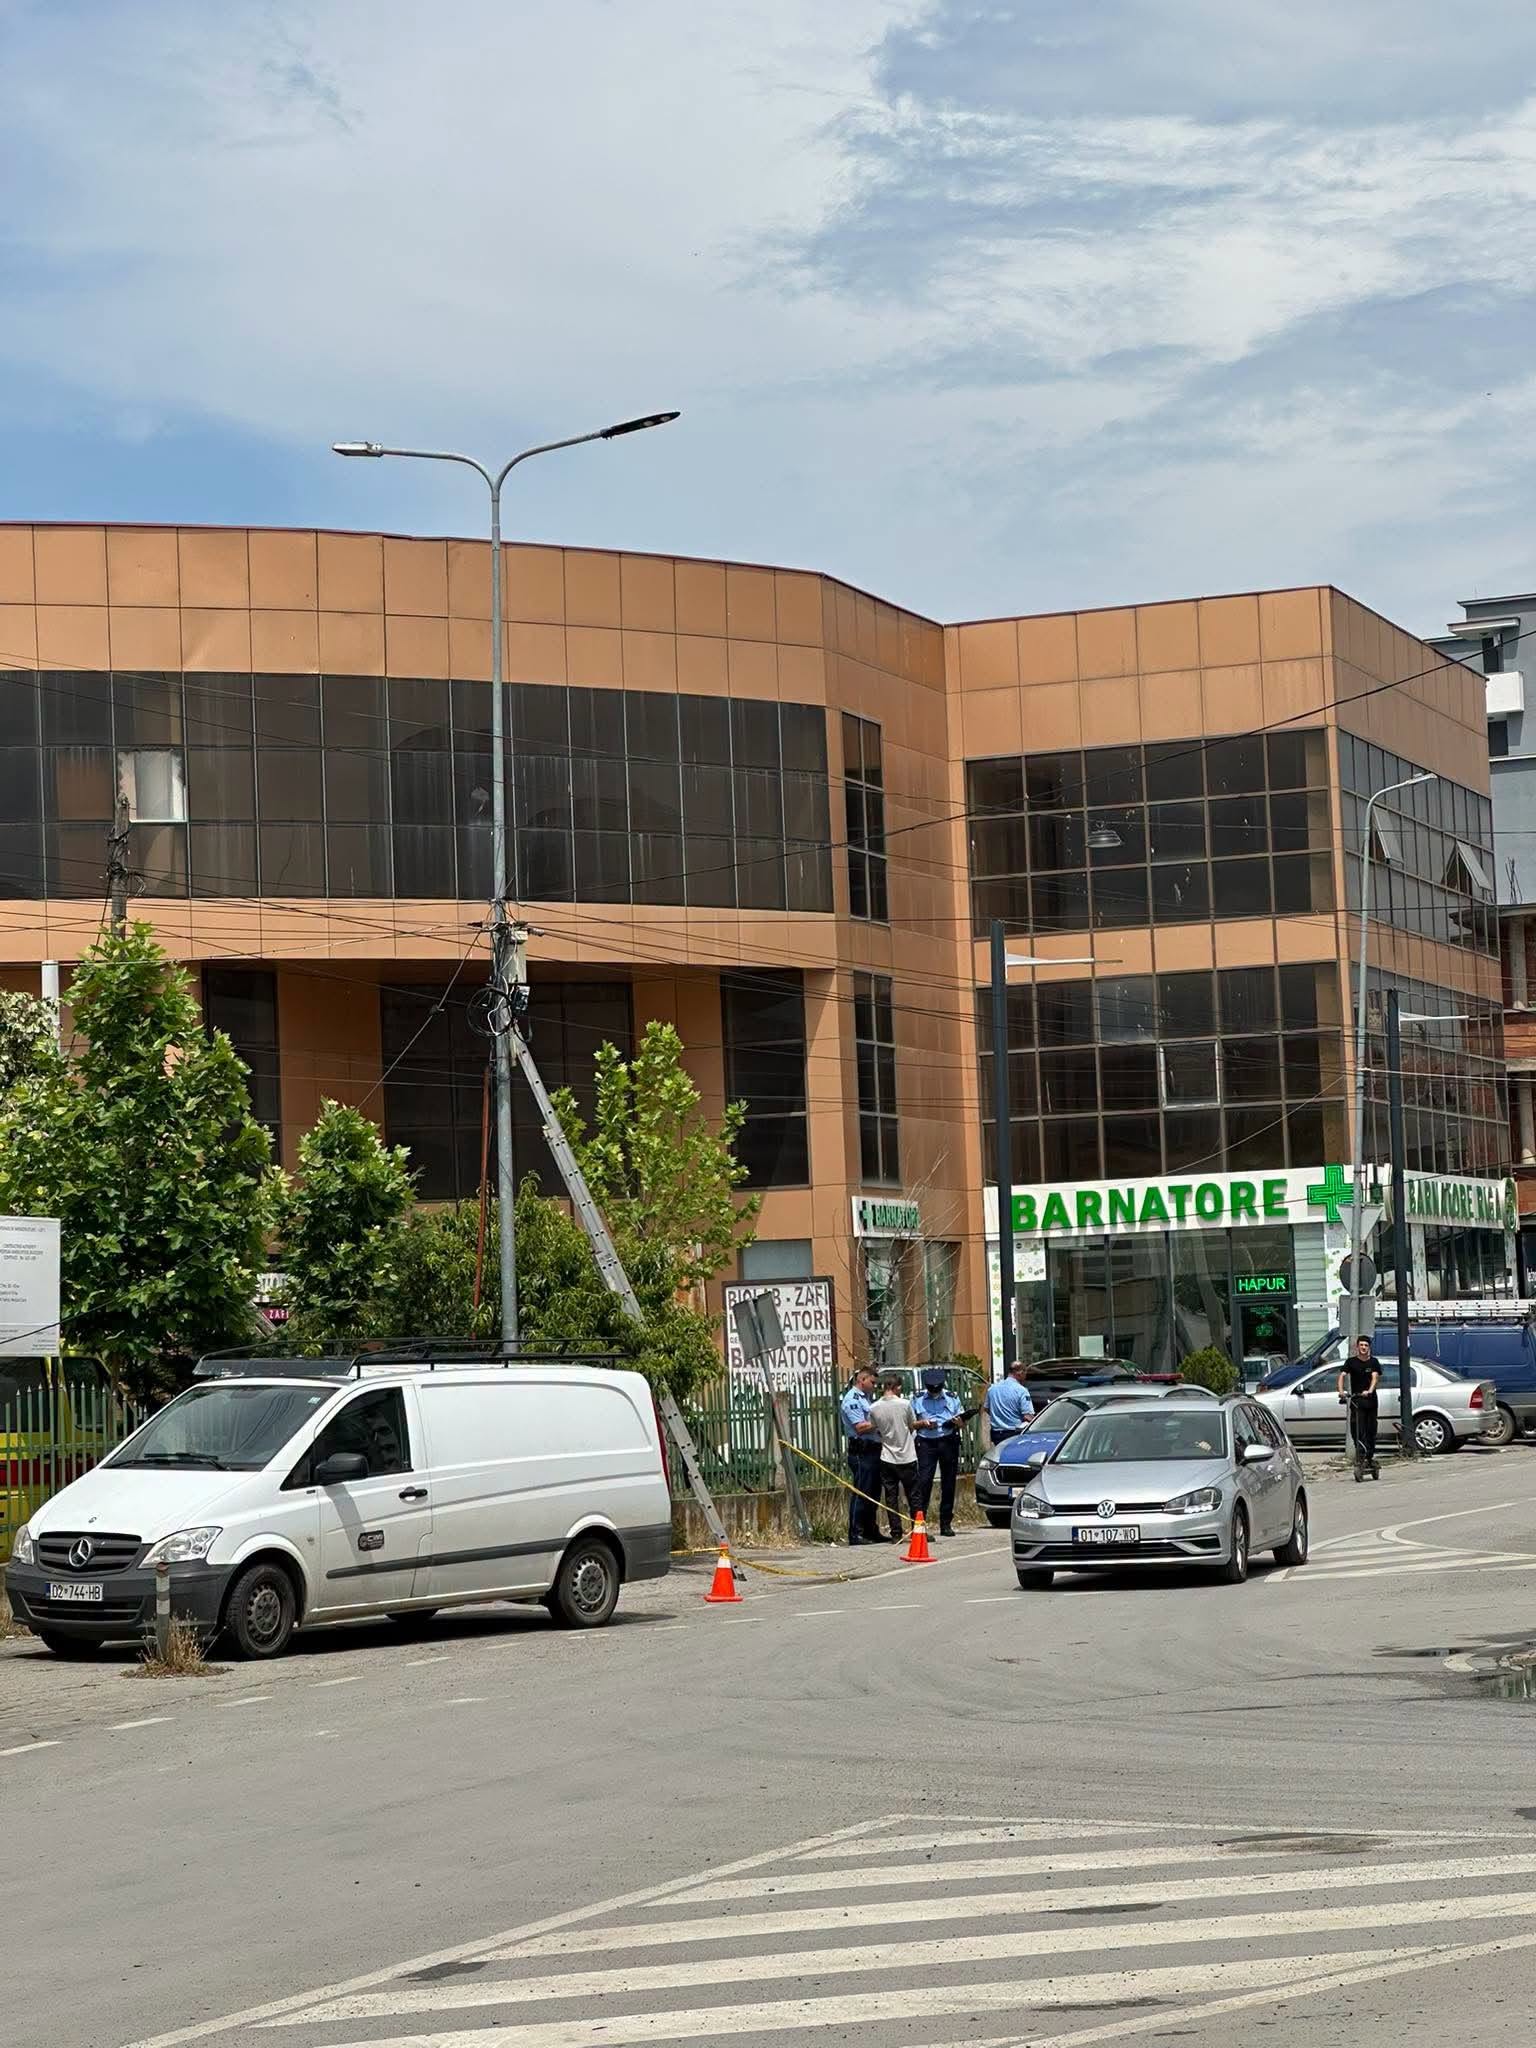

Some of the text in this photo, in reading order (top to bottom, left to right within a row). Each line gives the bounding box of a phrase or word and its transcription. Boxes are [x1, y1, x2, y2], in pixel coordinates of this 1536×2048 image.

[1011, 1178, 1289, 1232] BARNATORE
[1238, 1277, 1286, 1291] HAPUR
[728, 1288, 782, 1310] BIOLB
[795, 1285, 828, 1307] ZAFI
[729, 1310, 829, 1333] LATORI
